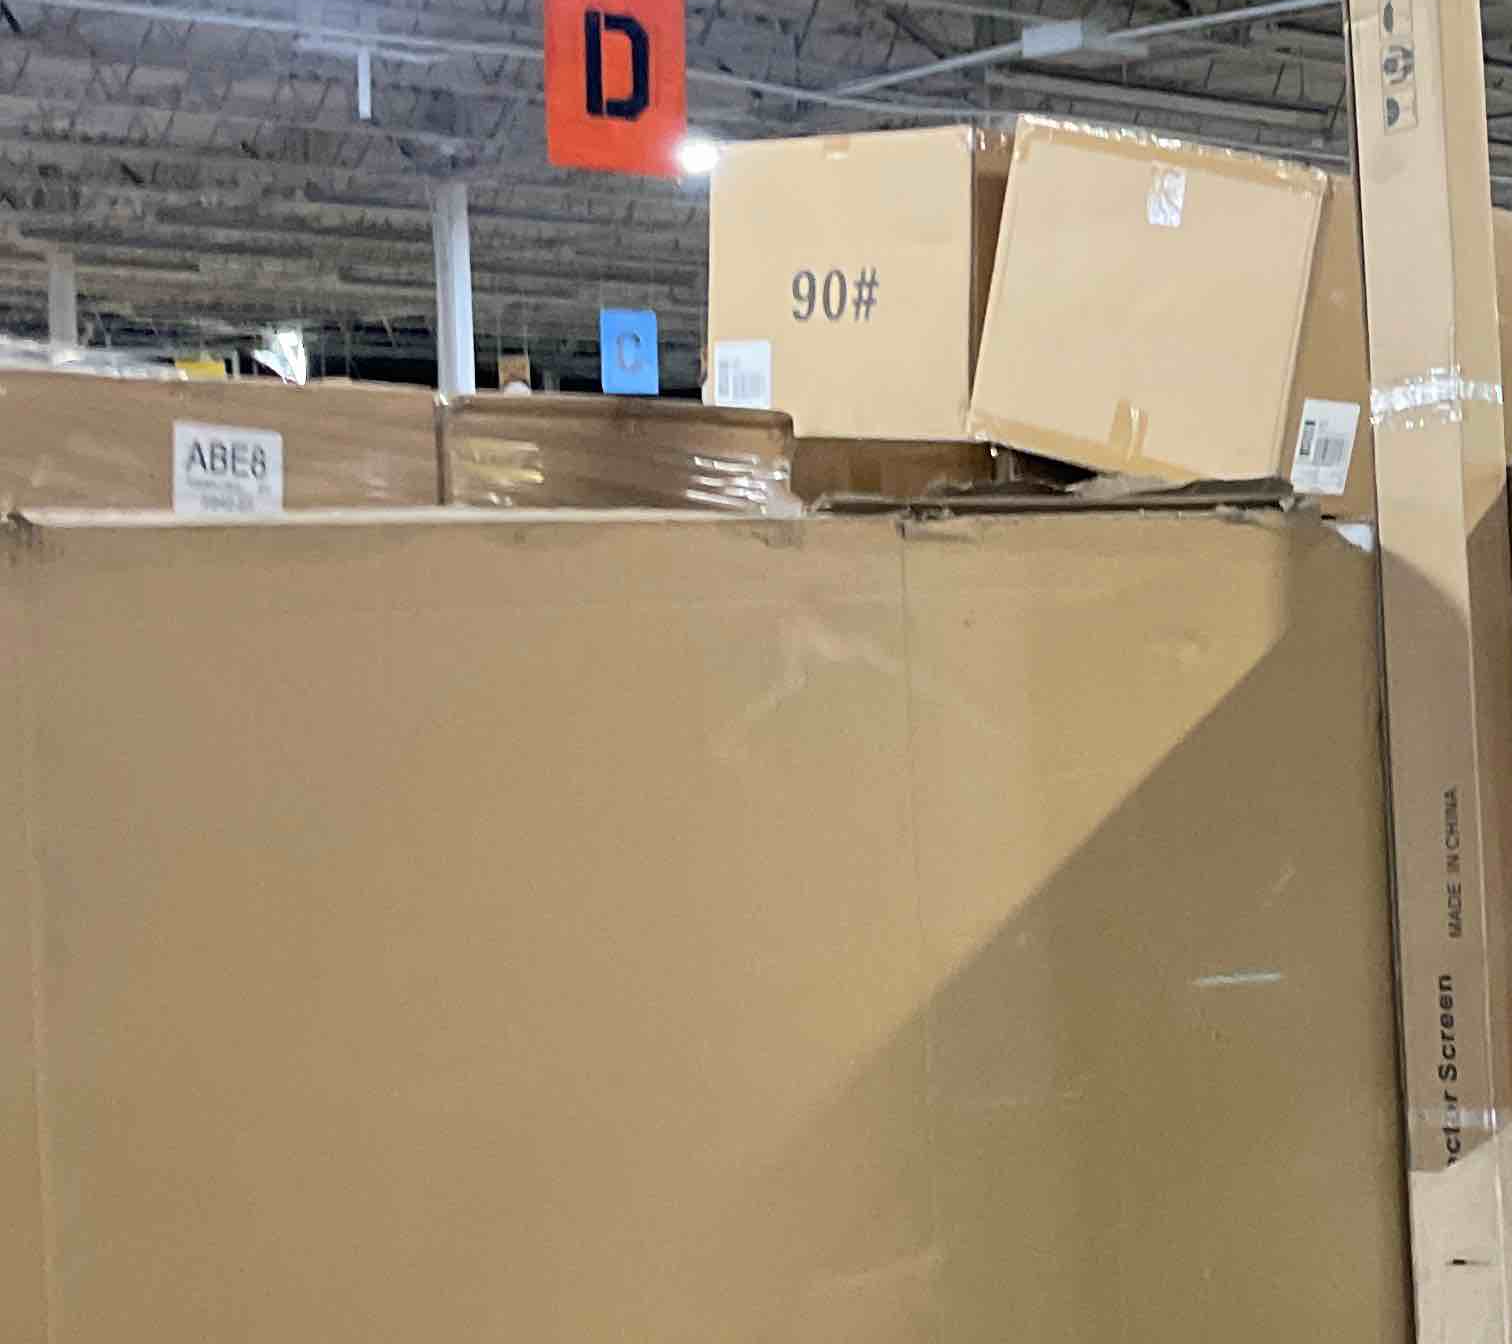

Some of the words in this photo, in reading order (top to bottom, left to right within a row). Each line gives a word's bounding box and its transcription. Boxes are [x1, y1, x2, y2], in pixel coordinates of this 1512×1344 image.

[584, 10, 650, 120] D
[791, 268, 881, 323] 90#
[615, 329, 643, 374] C
[185, 438, 267, 480] ABE8
[1446, 786, 1460, 851] CHINA
[1447, 853, 1460, 873] IN
[1448, 881, 1463, 939] MADE
[1436, 974, 1456, 1083] Screen
